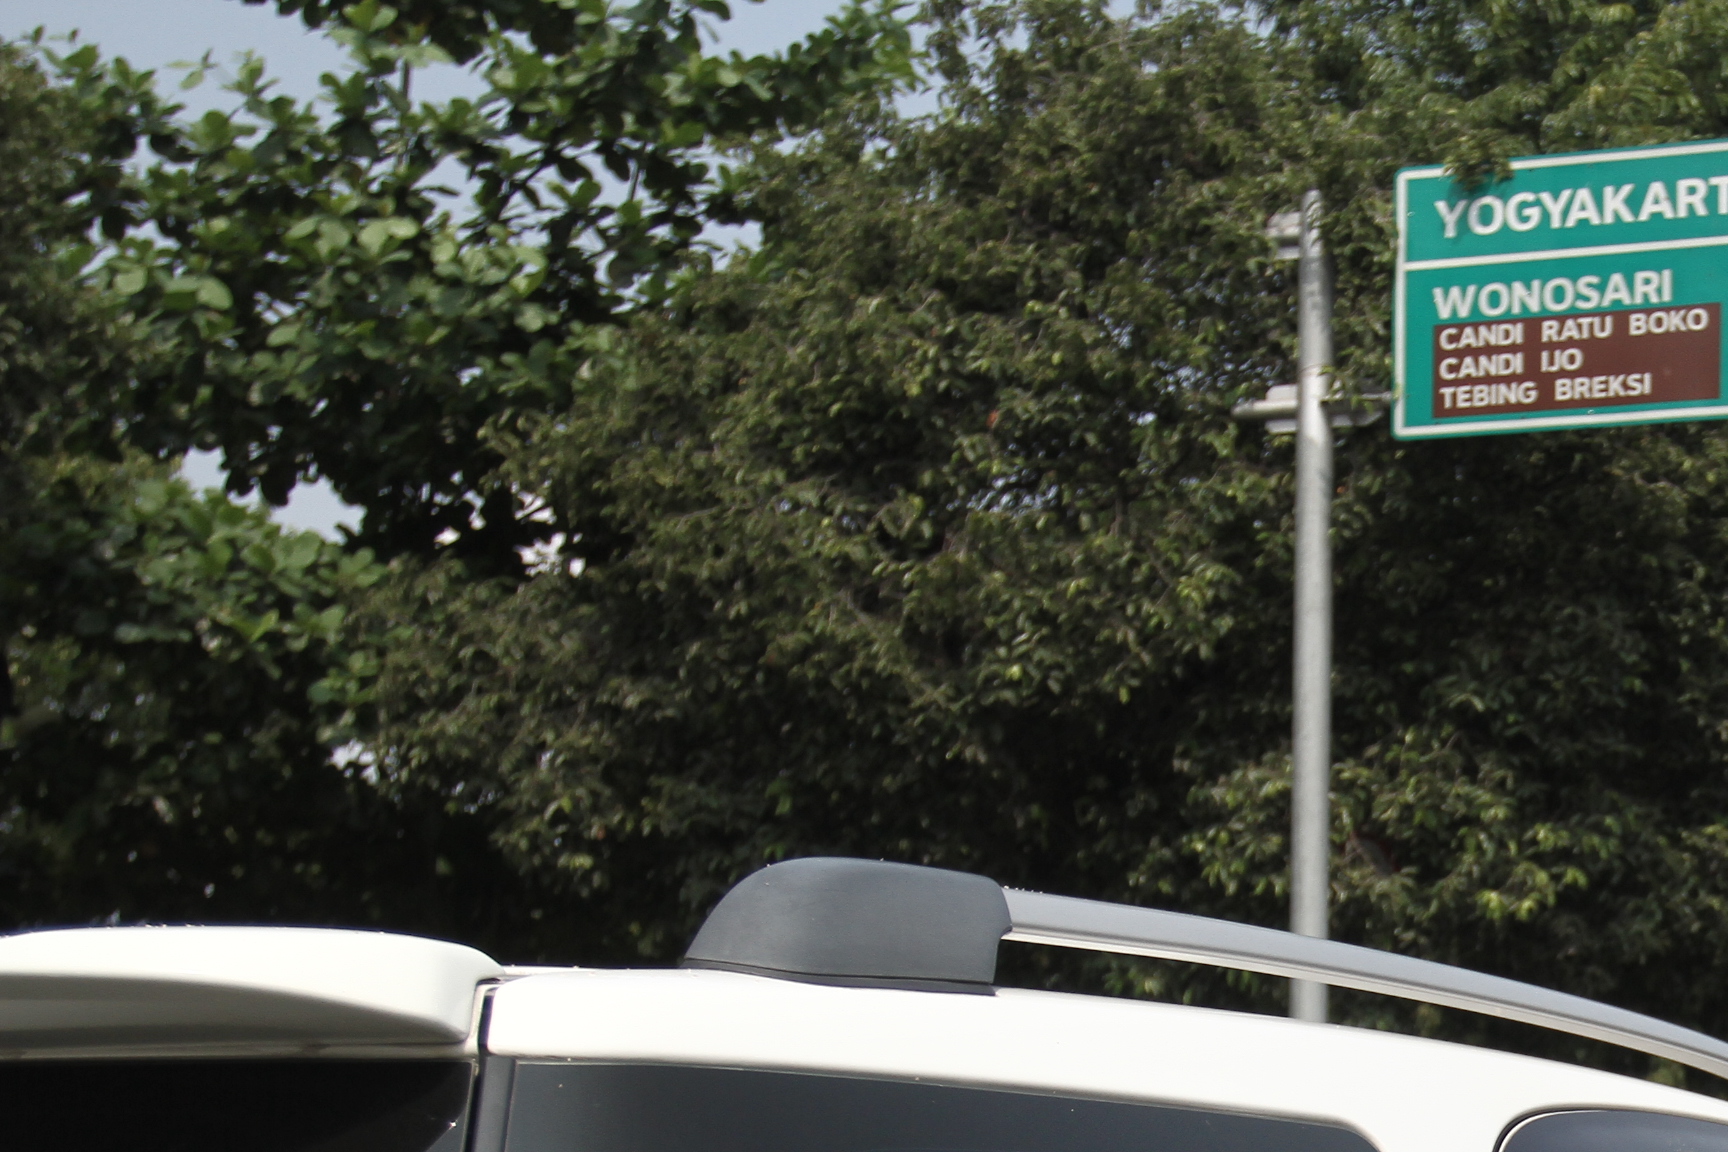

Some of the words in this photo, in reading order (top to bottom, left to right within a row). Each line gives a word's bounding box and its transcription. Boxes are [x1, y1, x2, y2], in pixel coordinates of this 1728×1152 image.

[1432, 268, 1674, 320] WONOSARI
[1439, 321, 1524, 351] CANDI
[1540, 314, 1614, 344] RATU
[1628, 307, 1710, 337] BOKO
[1439, 351, 1524, 381] CANDI
[1540, 347, 1584, 374] IJO
[1439, 380, 1539, 410] TEBING
[1554, 372, 1652, 401] BREKSI
